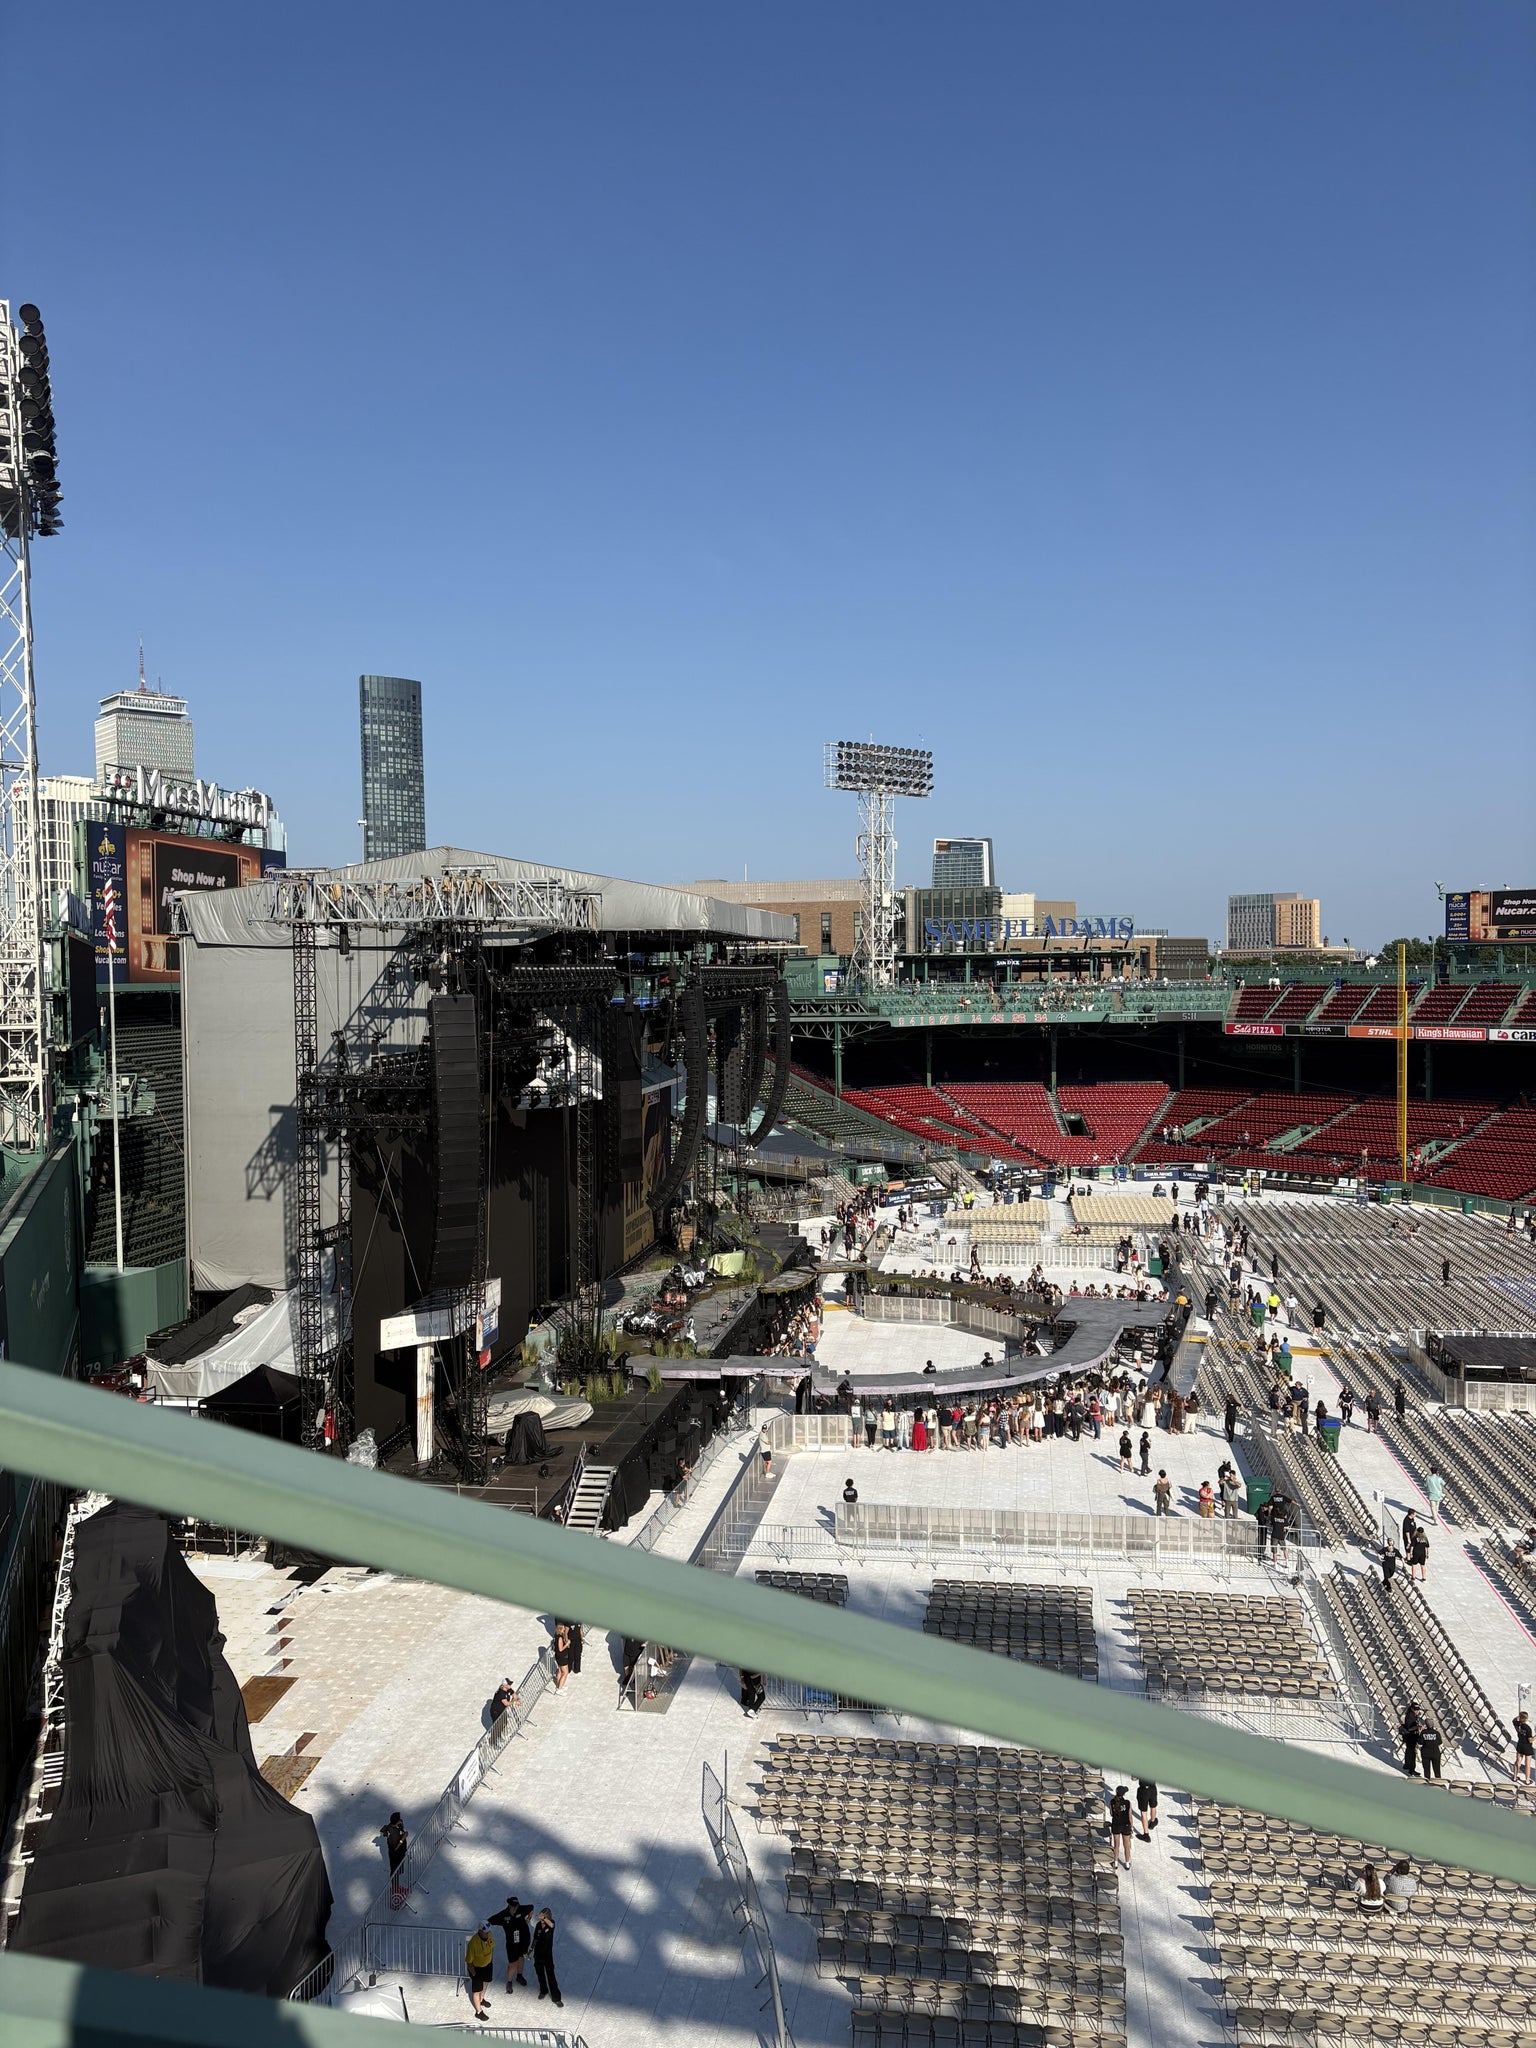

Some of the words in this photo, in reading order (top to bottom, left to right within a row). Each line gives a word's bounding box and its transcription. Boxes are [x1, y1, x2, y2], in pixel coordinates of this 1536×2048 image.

[136, 765, 268, 829] MassMutual
[93, 861, 121, 875] nuar
[171, 867, 194, 886] Shop
[195, 871, 216, 887] Now
[216, 875, 226, 888] at
[925, 918, 1034, 946] SAMUEL
[1038, 914, 1134, 941] ADAMS
[95, 955, 127, 964] Nuca.com
[1056, 1012, 1068, 1022] 42
[1252, 1026, 1275, 1034] PIZZA
[1368, 1028, 1393, 1036] STIHL
[1418, 1028, 1442, 1038] King's
[1442, 1029, 1483, 1039] Hawaiian
